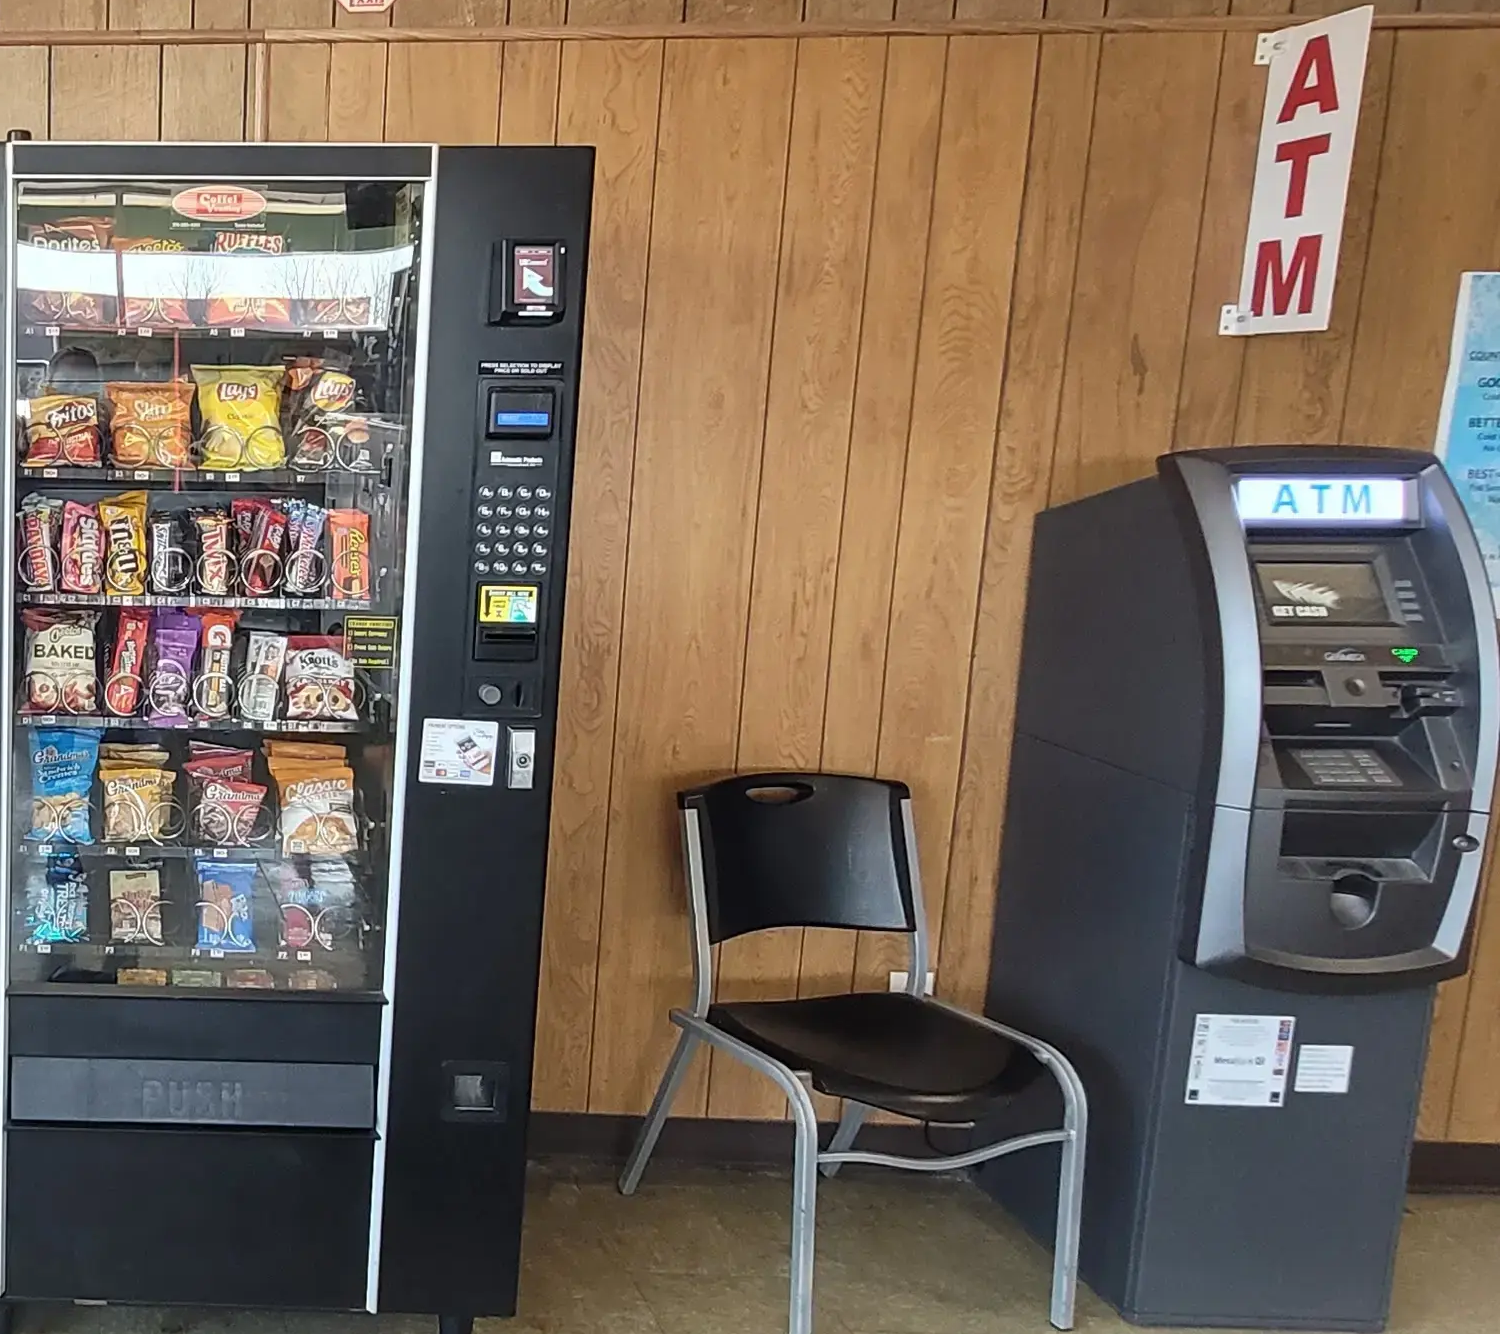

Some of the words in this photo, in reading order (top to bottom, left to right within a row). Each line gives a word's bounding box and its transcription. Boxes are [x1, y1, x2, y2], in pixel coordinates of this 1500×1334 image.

[1250, 33, 1340, 318] ATM
[215, 231, 285, 254] RUFFLES
[45, 402, 95, 427] Fritos
[1271, 483, 1372, 514] ATM
[33, 644, 95, 660] BAKED
[300, 650, 339, 670] Knott's
[37, 764, 81, 778] Sandwich
[285, 778, 348, 802] Classic
[142, 1080, 243, 1118] PUSH
